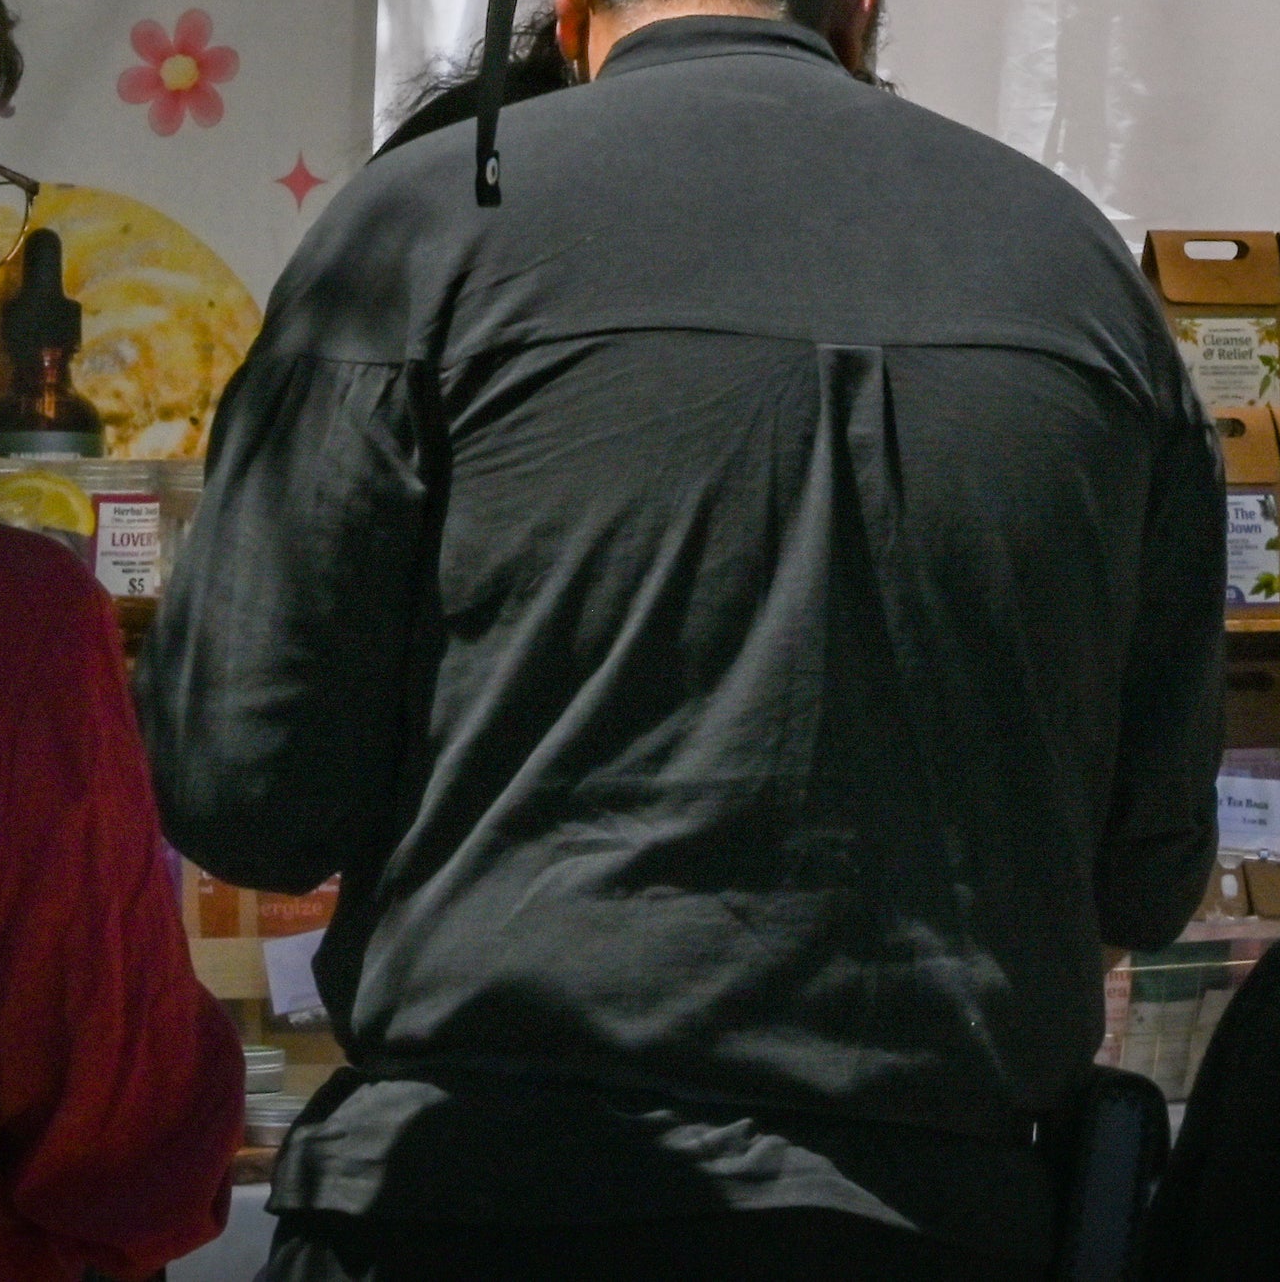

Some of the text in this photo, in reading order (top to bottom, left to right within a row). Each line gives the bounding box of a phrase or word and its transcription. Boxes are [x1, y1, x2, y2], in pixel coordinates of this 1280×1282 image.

[1203, 334, 1252, 346] Cleanse
[1218, 348, 1253, 360] Relief
[1234, 507, 1255, 520] The
[128, 577, 145, 594] $5
